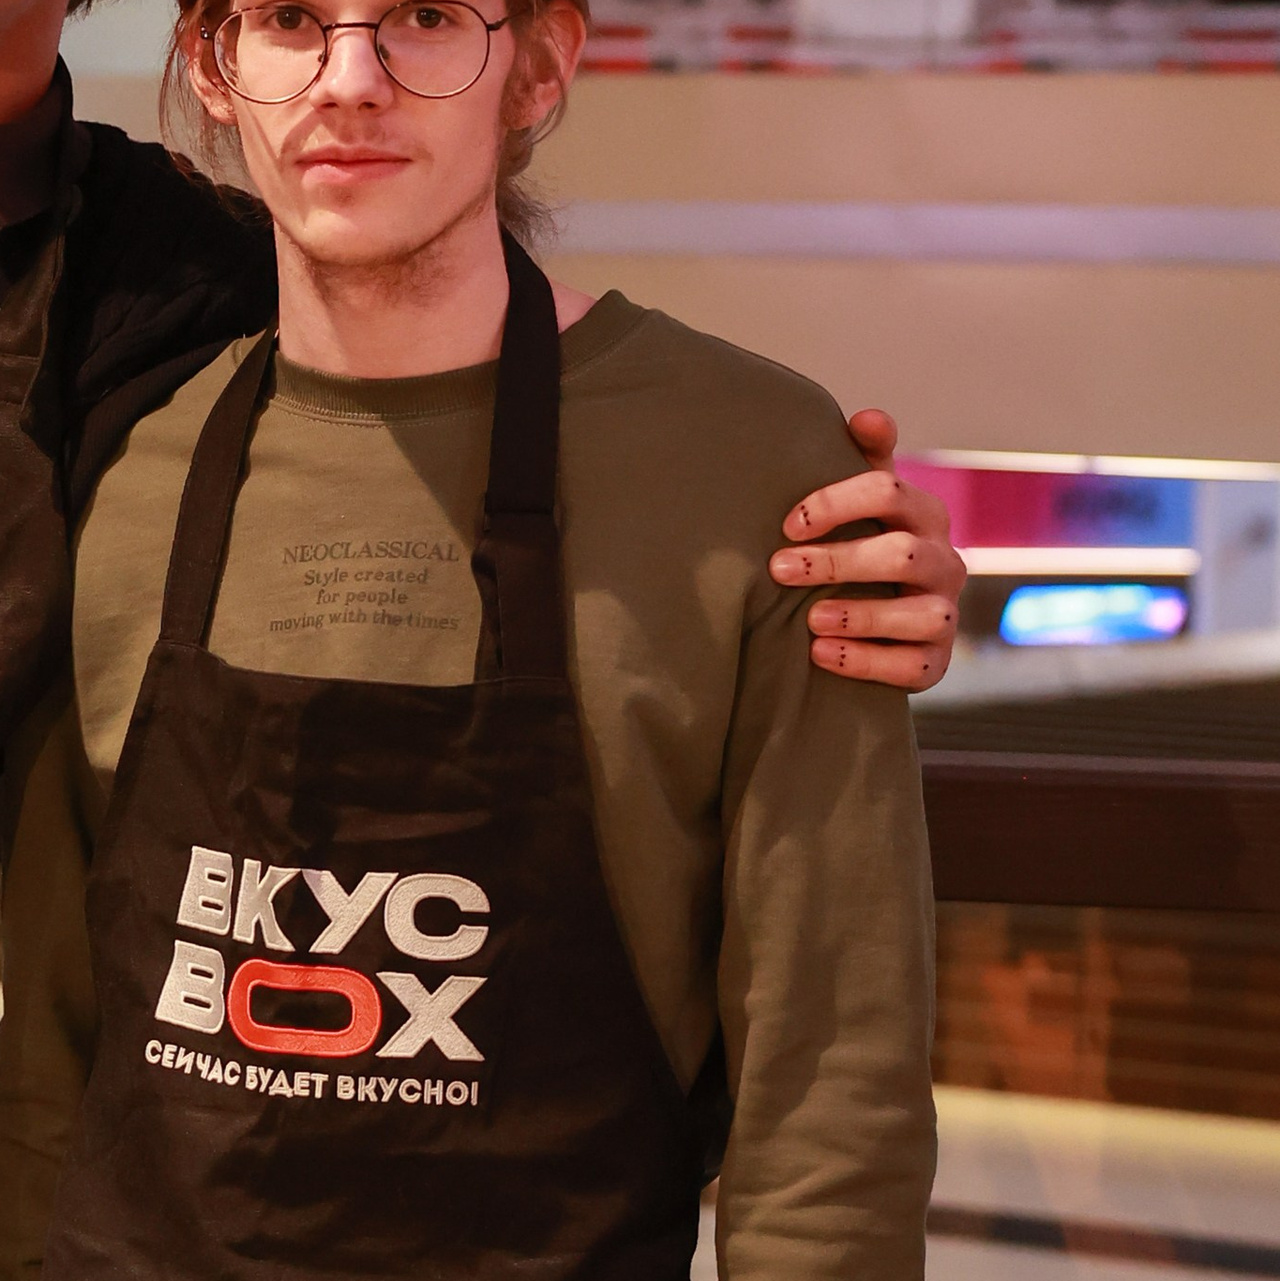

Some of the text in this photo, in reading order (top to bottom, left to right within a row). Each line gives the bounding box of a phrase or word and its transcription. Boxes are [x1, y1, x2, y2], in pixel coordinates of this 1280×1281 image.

[282, 540, 460, 565] NEOCLASSICAL
[304, 567, 429, 587] Style created
[316, 587, 409, 606] for people
[270, 607, 461, 632] moving with the times
[176, 845, 491, 961] ВКУС
[154, 939, 488, 1061] BOX
[245, 1065, 329, 1099] БУДЕТ
[336, 1074, 479, 1107] ВКУСНО!
